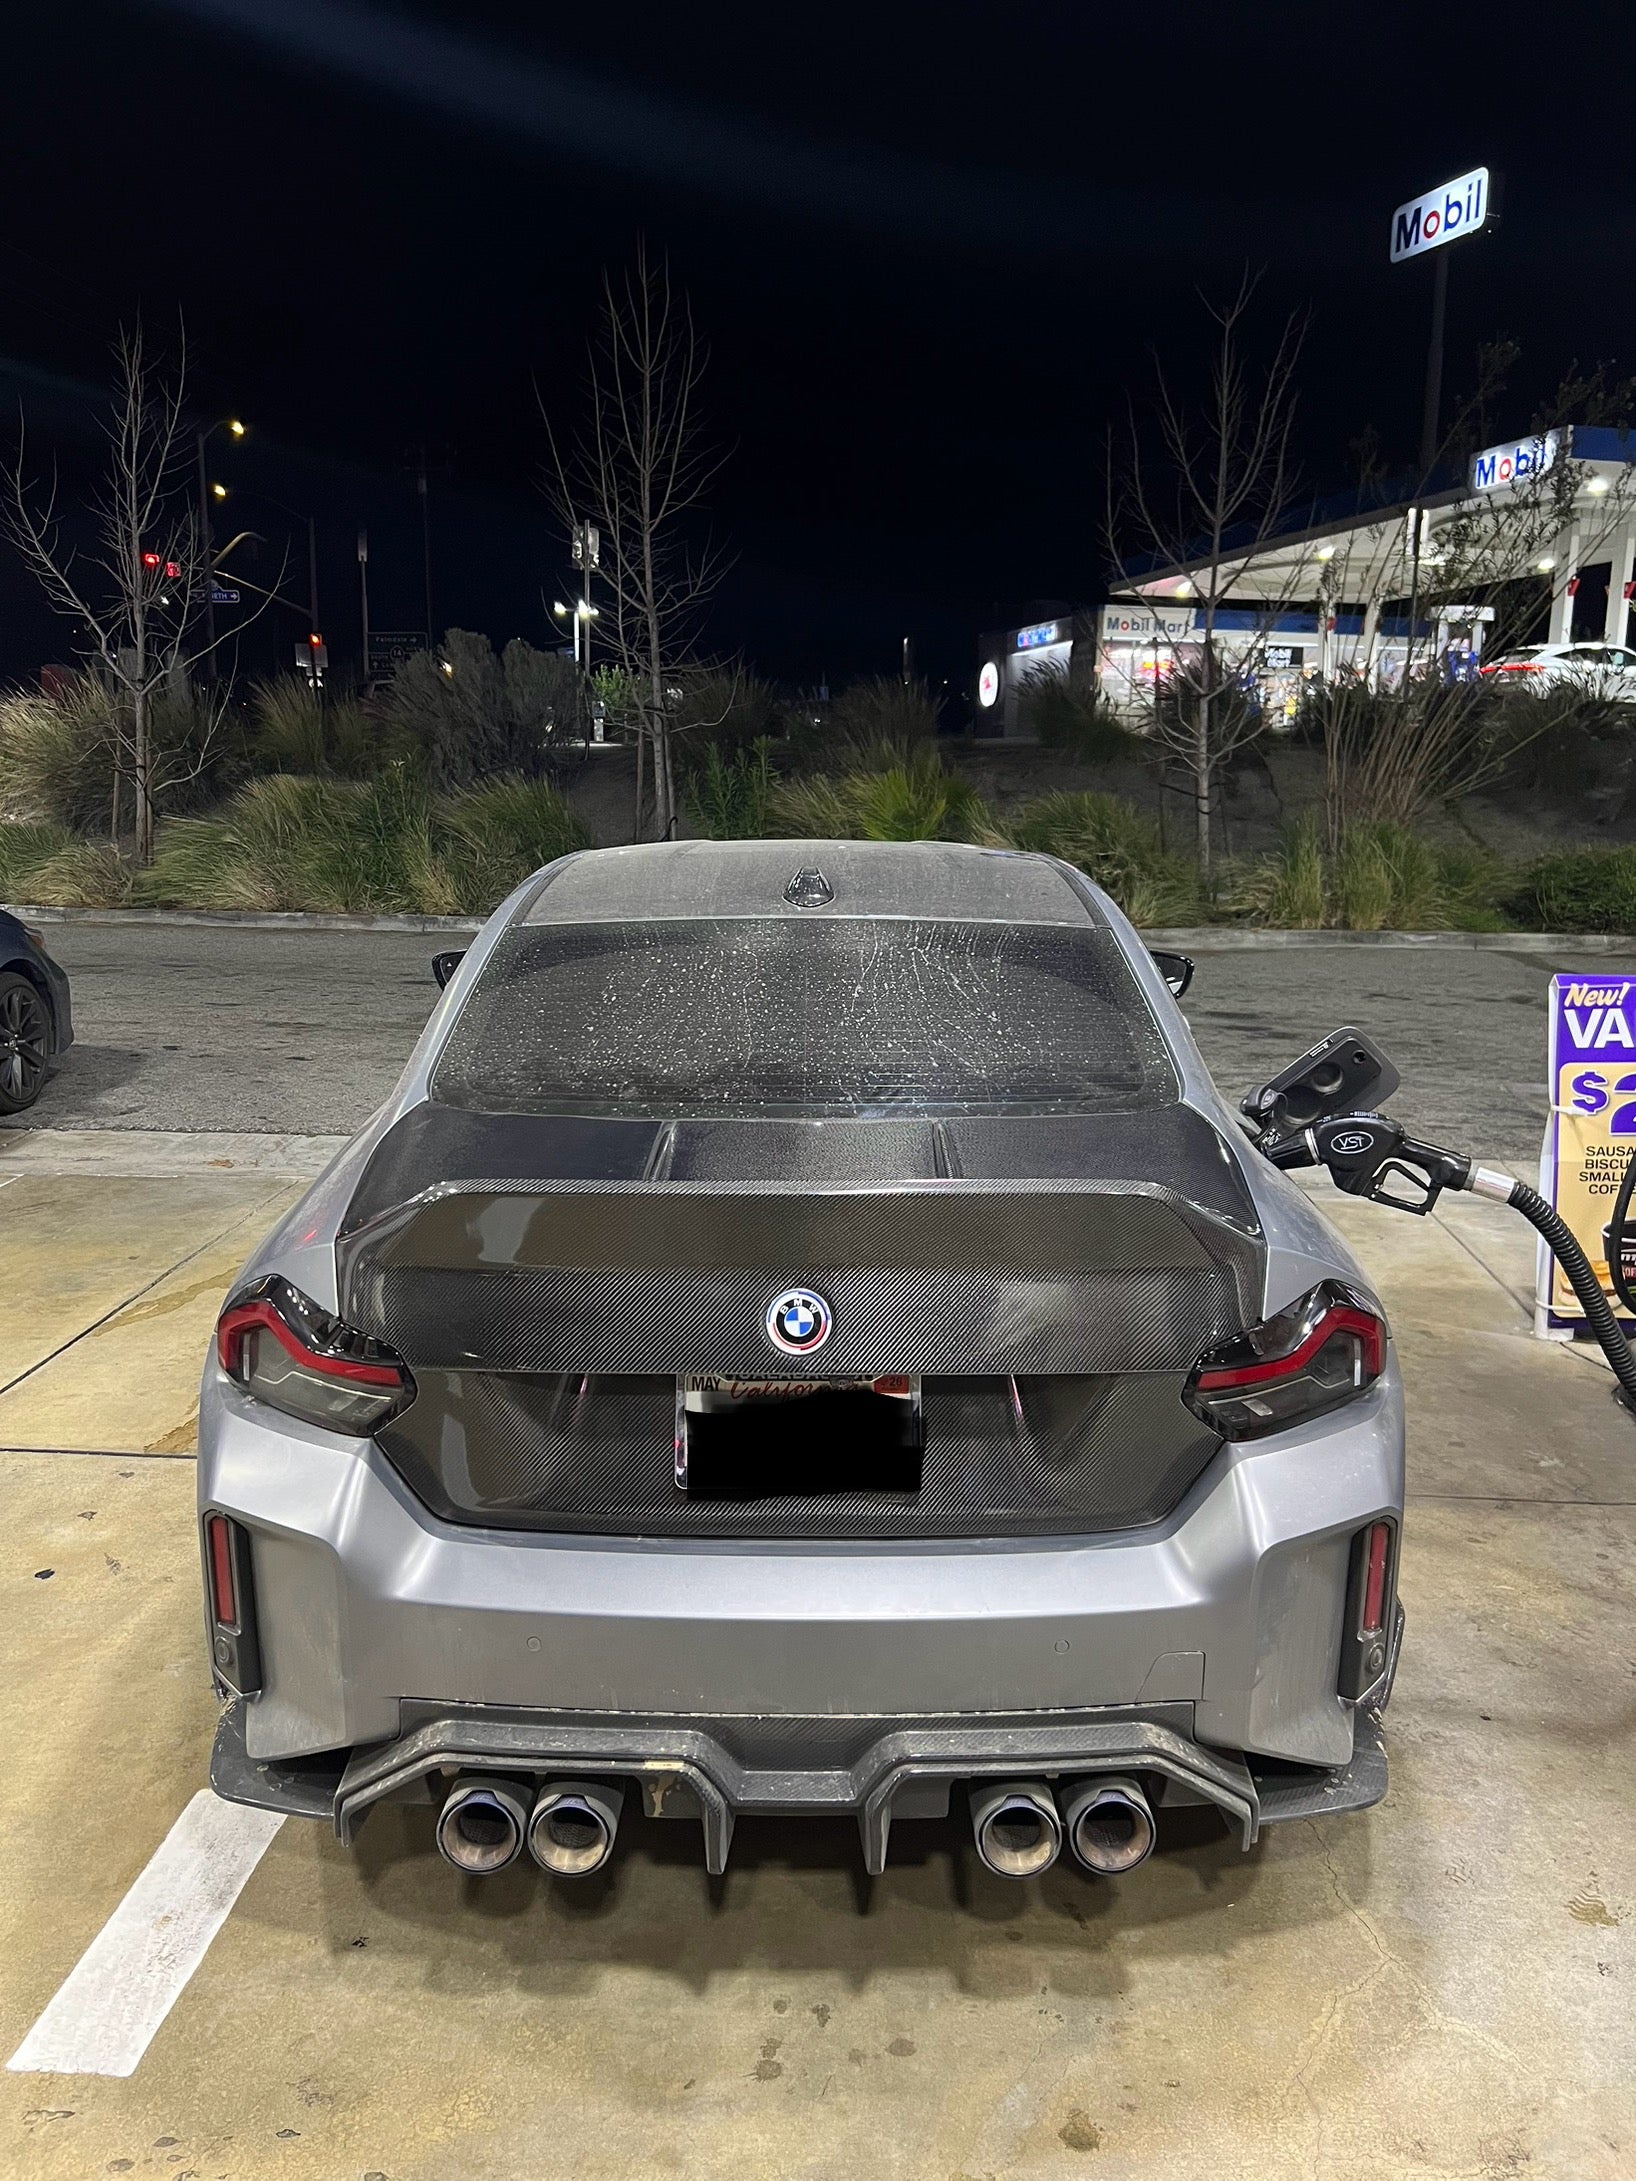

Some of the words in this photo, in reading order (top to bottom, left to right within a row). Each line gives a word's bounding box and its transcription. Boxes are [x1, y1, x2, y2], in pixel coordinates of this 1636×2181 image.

[1395, 178, 1482, 254] Mobil
[1107, 616, 1150, 631] Mobil
[1564, 982, 1631, 1007] New!
[1338, 1136, 1365, 1150] VST
[1586, 1146, 1636, 1157] SAUSA
[780, 1298, 819, 1315] BMW
[691, 1376, 720, 1391] MAY
[730, 1381, 860, 1400] Californ
